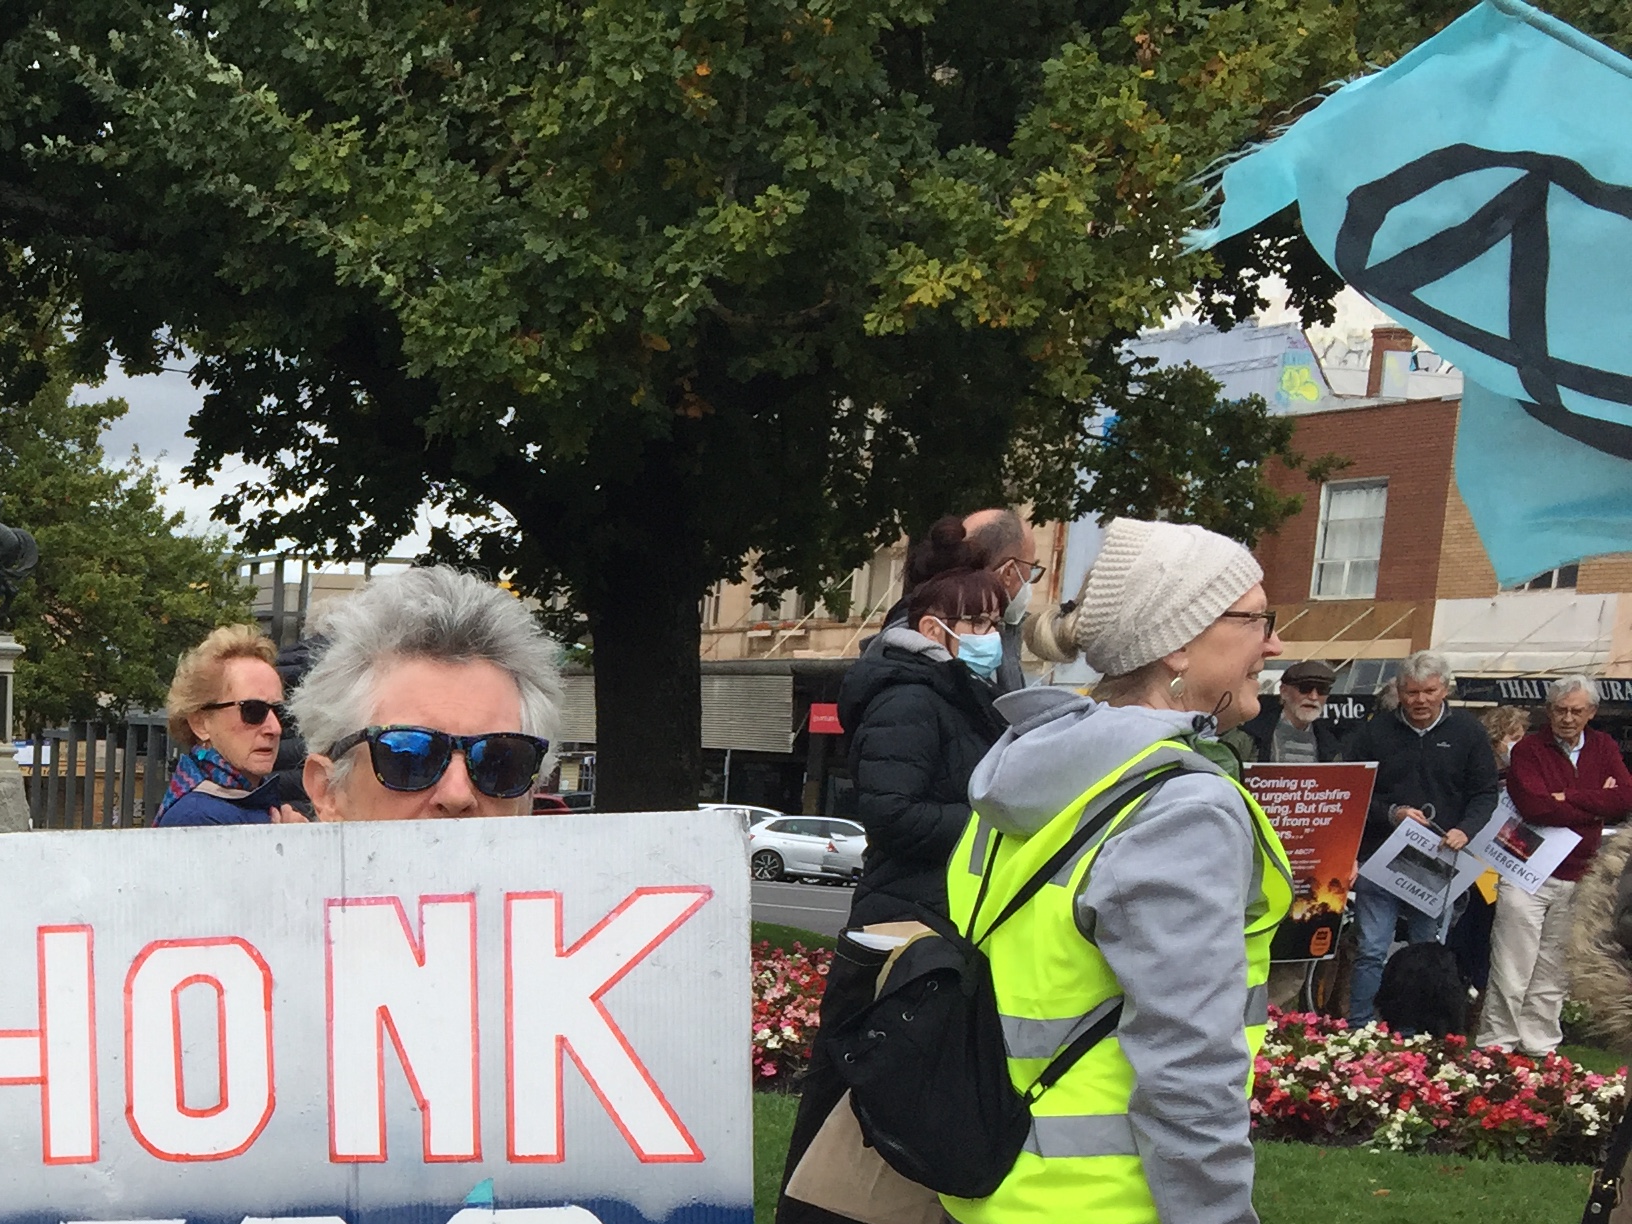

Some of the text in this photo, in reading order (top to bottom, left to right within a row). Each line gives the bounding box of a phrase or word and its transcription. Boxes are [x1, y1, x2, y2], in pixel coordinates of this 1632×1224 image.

[1496, 680, 1541, 699] THAI
[1322, 697, 1366, 725] ryde
[1300, 779, 1319, 790] up.
[1262, 791, 1302, 803] urgent
[1304, 789, 1351, 801] bushfire
[1295, 802, 1316, 814] But
[1318, 802, 1344, 815] first,
[1282, 816, 1311, 827] from
[1312, 817, 1333, 826] our
[1405, 827, 1430, 848] VOTE
[1484, 843, 1540, 884] EMERGENCY
[1395, 877, 1438, 906] CLIMATE
